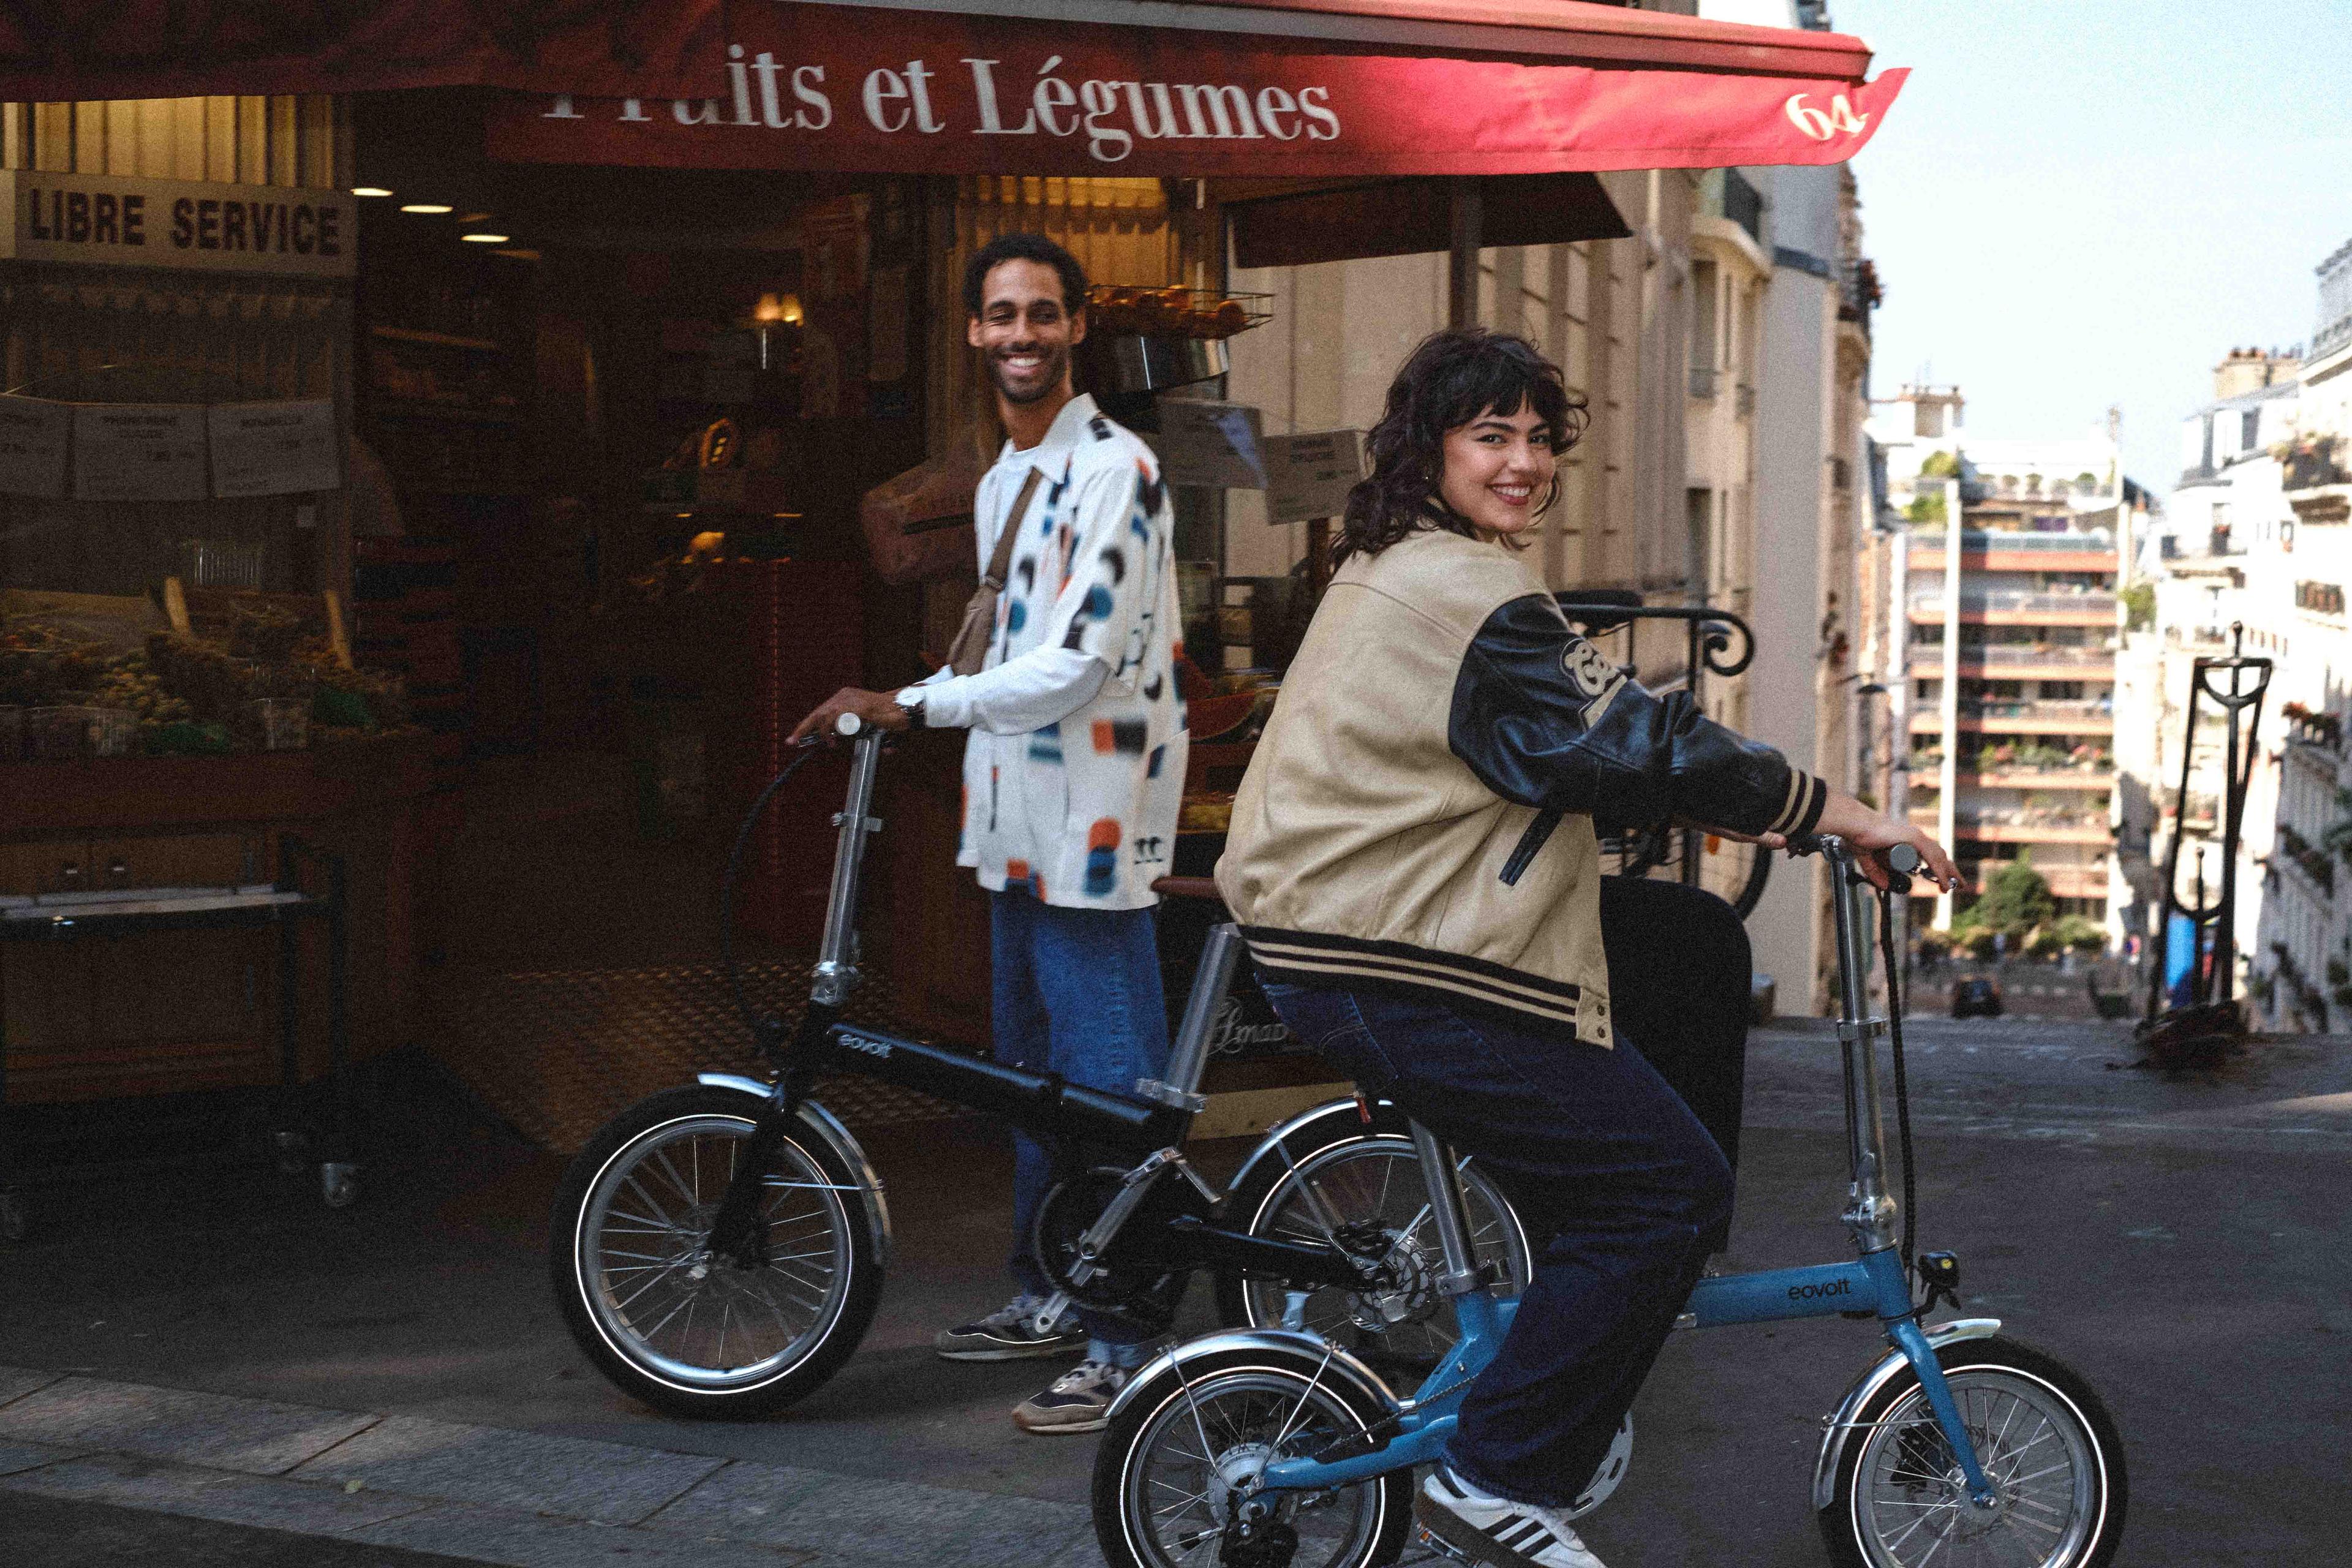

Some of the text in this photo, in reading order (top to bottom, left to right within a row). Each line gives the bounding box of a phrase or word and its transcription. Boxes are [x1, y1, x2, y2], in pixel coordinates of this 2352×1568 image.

[541, 44, 1340, 162] its et Légumes
[1785, 93, 1869, 141] 64
[30, 188, 340, 256] LIBRE SERVICE
[1789, 1278, 1852, 1299] eovolt
